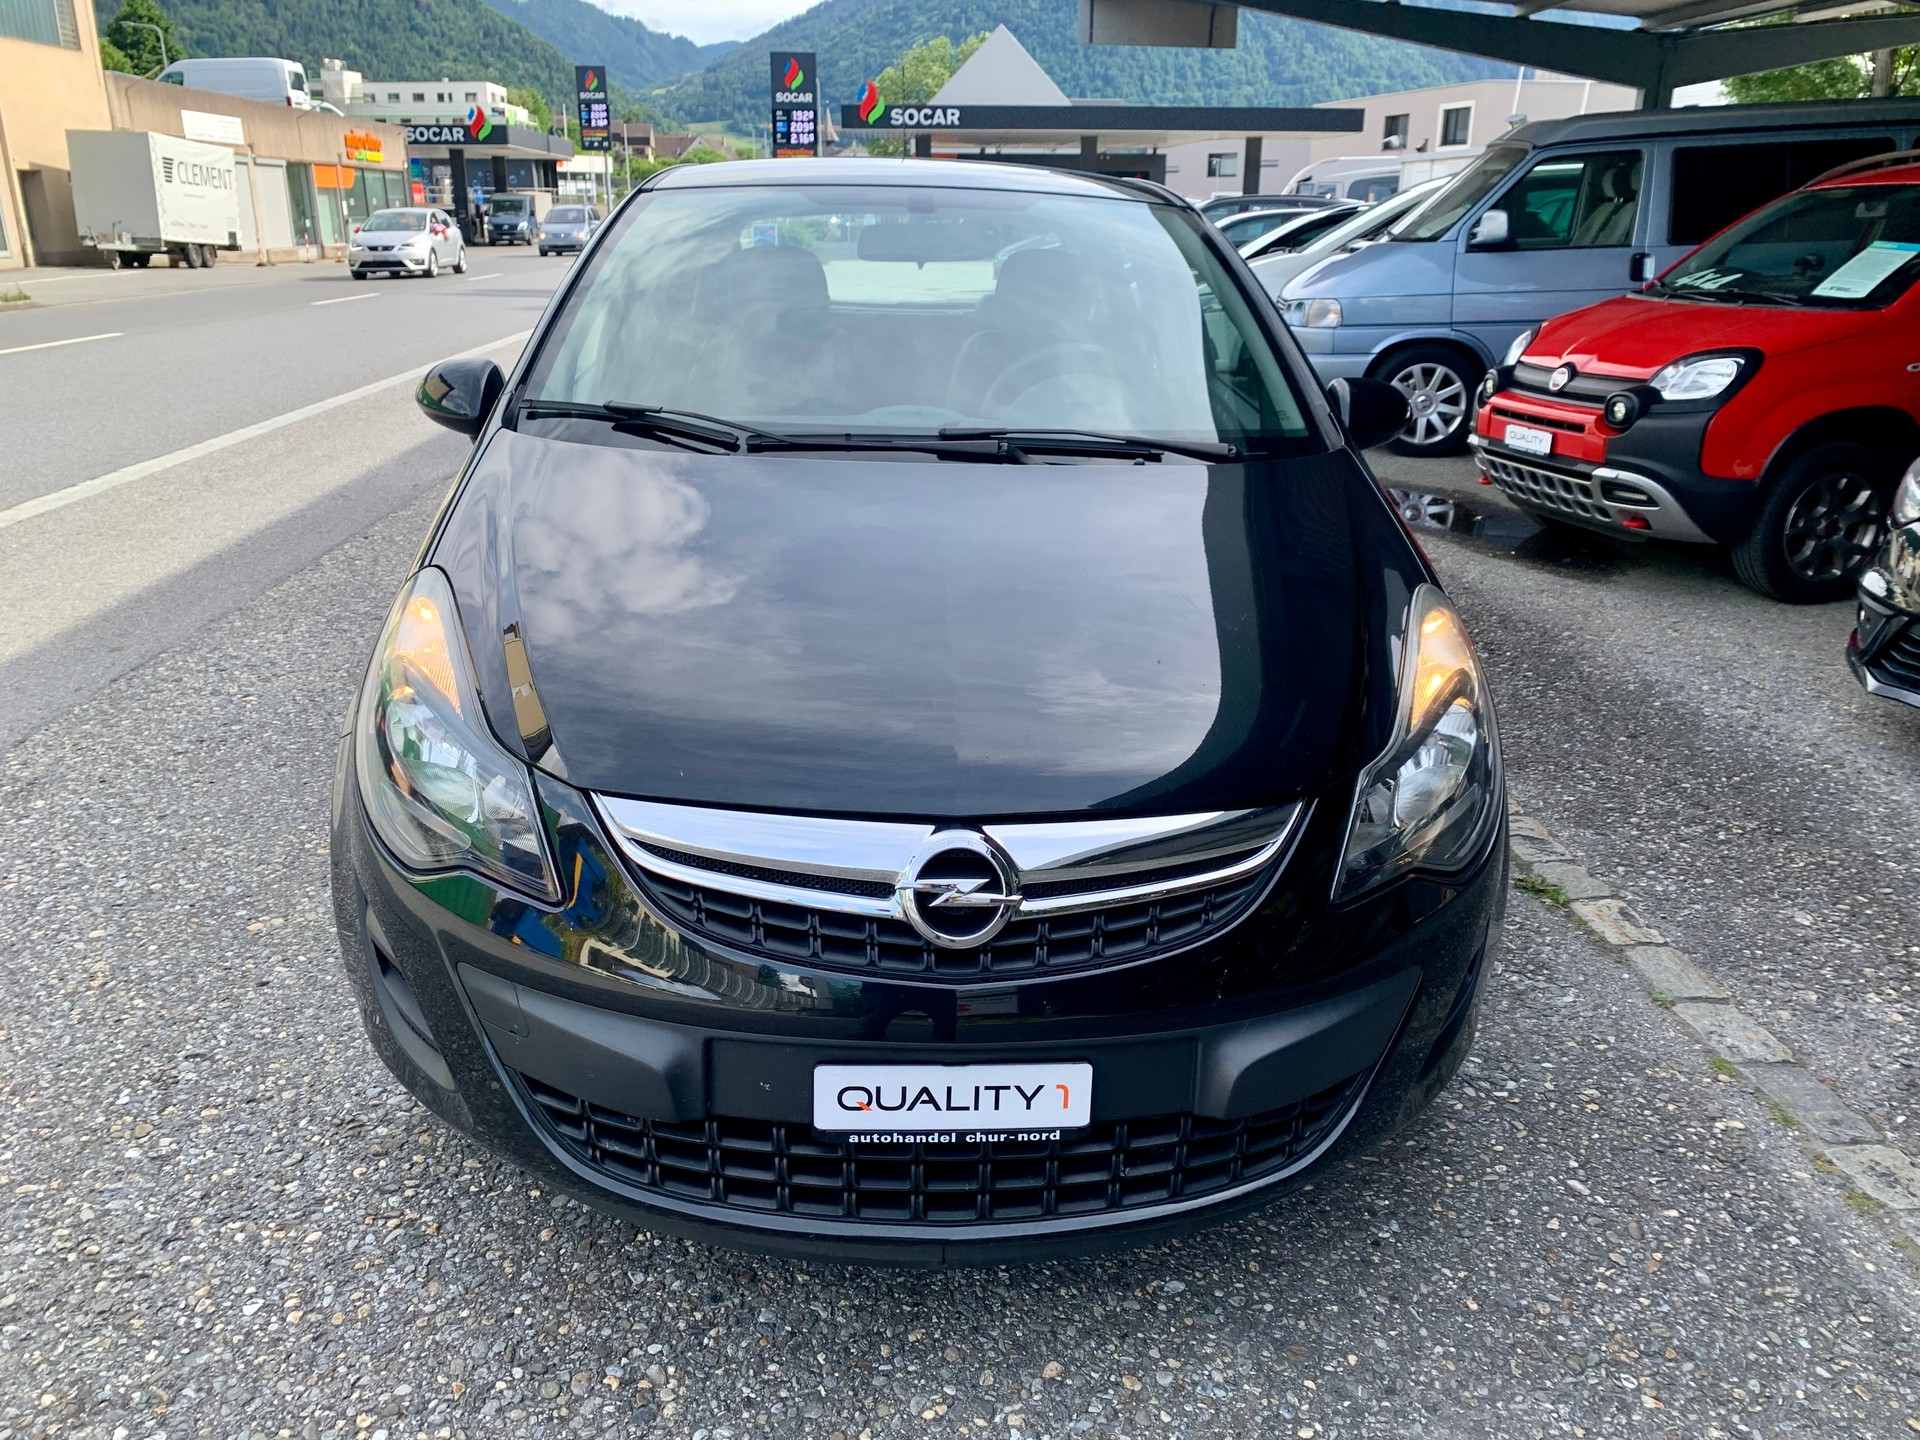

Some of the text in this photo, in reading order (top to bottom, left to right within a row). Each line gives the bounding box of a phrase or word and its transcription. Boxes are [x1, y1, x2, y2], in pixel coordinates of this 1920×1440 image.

[775, 92, 813, 103] SOCAR
[890, 108, 960, 125] SOCAR
[406, 127, 465, 142] SOCAR
[177, 161, 233, 191] CLEMENT
[1510, 431, 1544, 446] QUALITY
[837, 1084, 1069, 1111] QUALITY 1
[849, 1130, 1060, 1143] autohandel chur-nord
